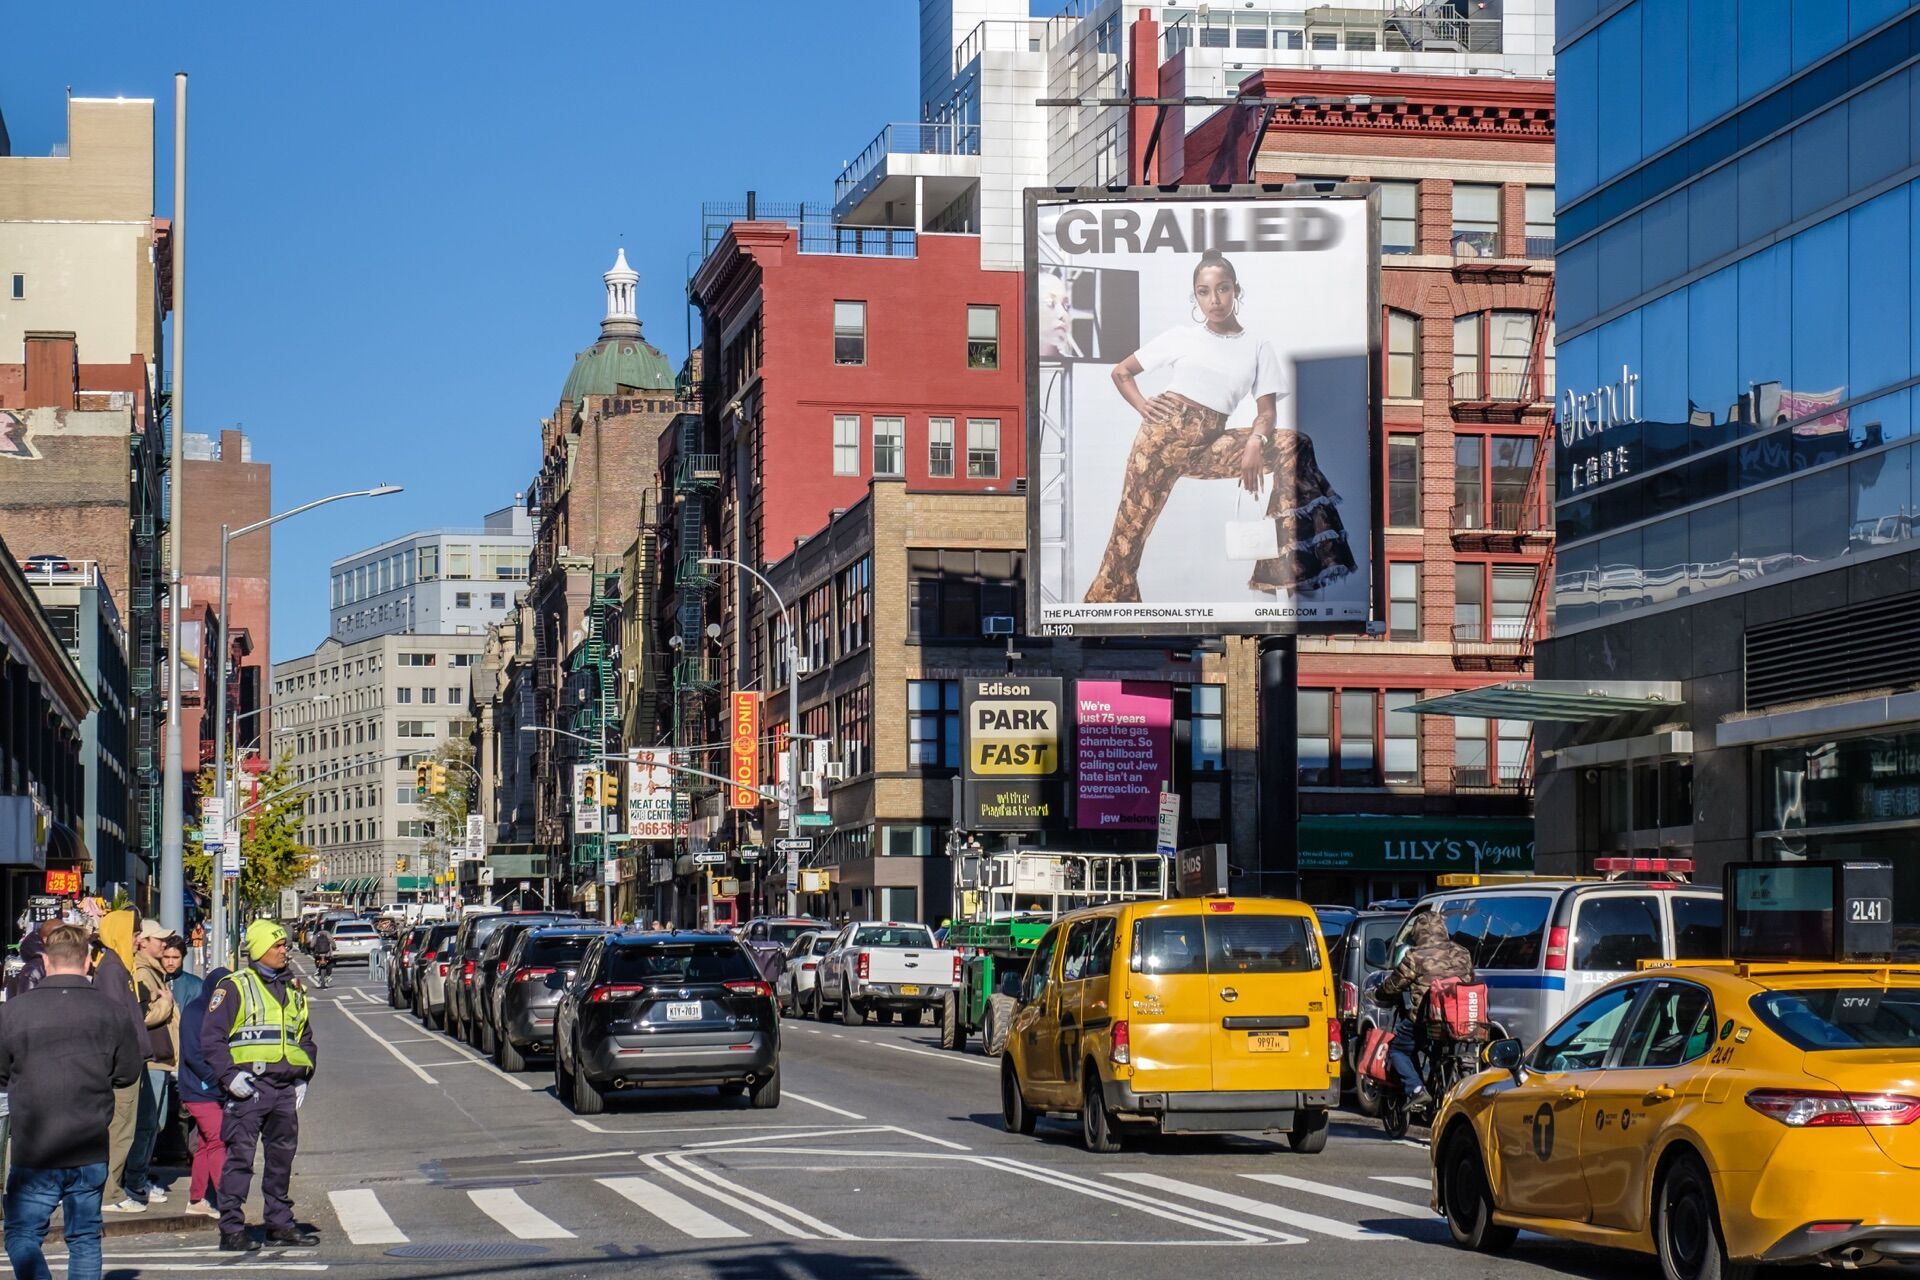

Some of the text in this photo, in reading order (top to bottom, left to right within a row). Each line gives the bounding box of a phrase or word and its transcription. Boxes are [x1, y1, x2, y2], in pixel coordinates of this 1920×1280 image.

[1056, 208, 1345, 255] GRAILED
[1044, 608, 1214, 618] THE PLATFORM FOR PERSONAL STYLE
[1255, 608, 1317, 616] GRAILED.COM
[1042, 624, 1074, 636] M-1120
[978, 682, 1030, 696] Edison
[1080, 701, 1110, 711] We're
[979, 709, 1049, 730] PARK
[1080, 713, 1146, 724] just 75 years
[1080, 726, 1148, 736] since the gas
[1080, 737, 1152, 746] chambers. So
[738, 696, 752, 804] JING FONG
[980, 744, 1048, 765] FAST
[1080, 750, 1096, 759] no,
[1106, 749, 1152, 758] billboard
[1080, 760, 1158, 772] calling out Jew
[1080, 772, 1104, 782] hate
[1106, 772, 1128, 782] isn't
[1080, 784, 1150, 794] overreaction.
[630, 799, 653, 810] MEAT
[1100, 812, 1156, 824] jewbelong
[1384, 838, 1461, 860] LILY'S
[1466, 840, 1522, 864] Vegan
[1852, 900, 1882, 920] 2L41
[242, 1030, 263, 1040] NY
[1711, 1046, 1734, 1064] 2L41
